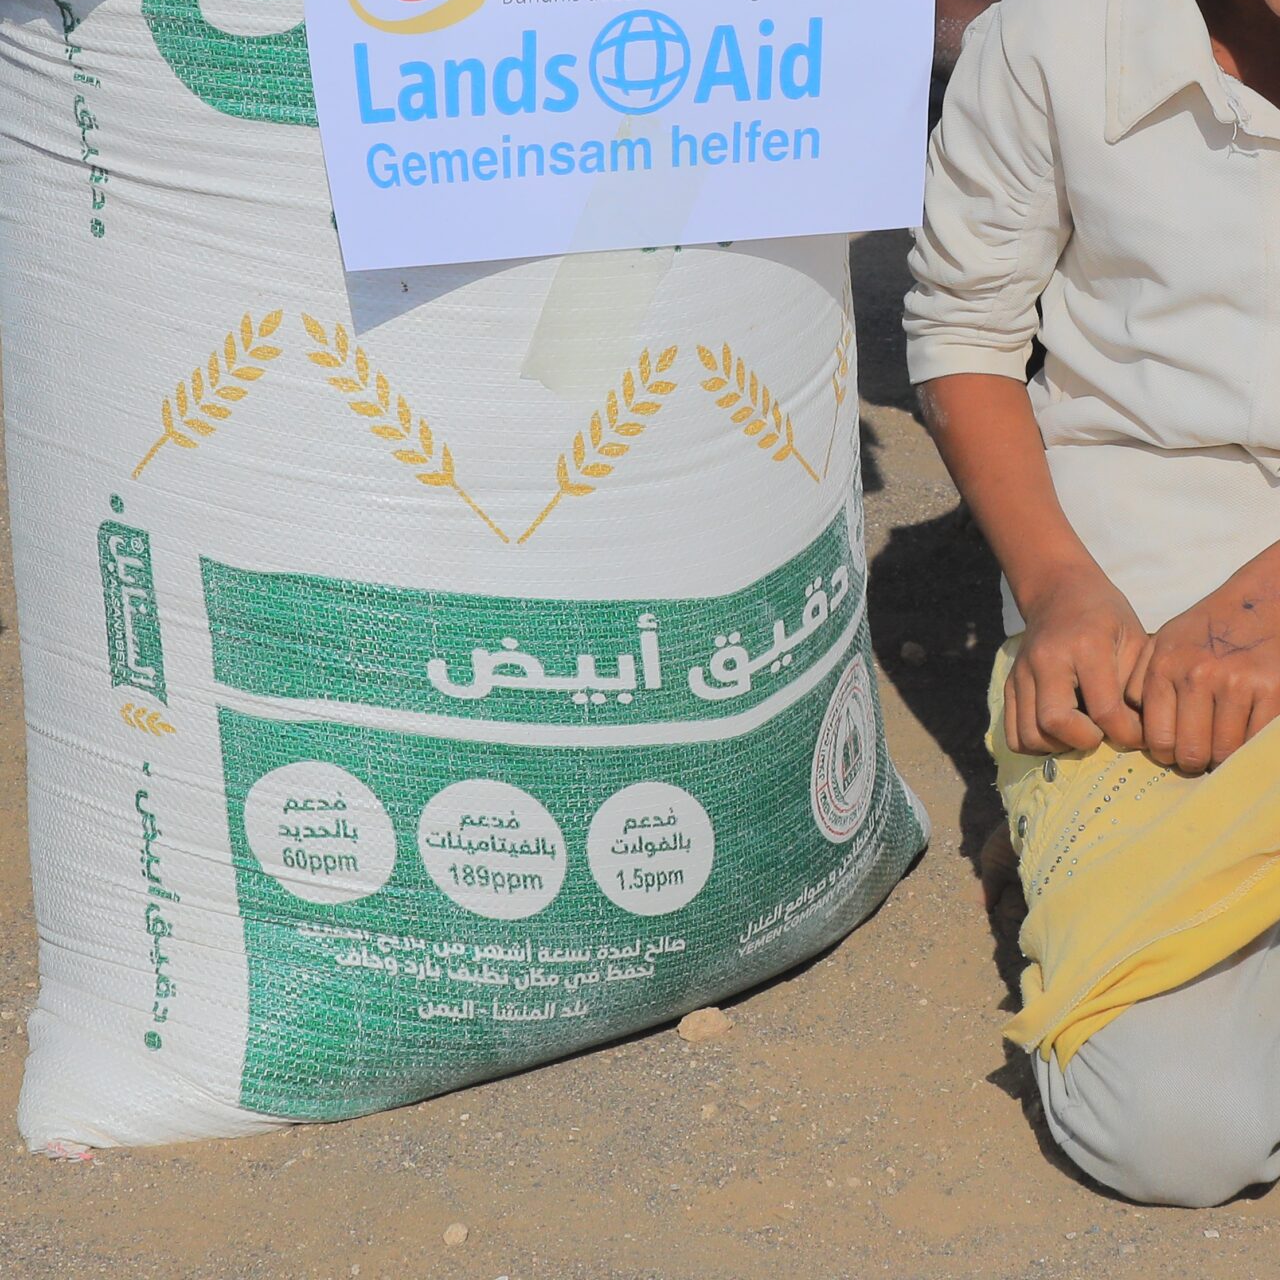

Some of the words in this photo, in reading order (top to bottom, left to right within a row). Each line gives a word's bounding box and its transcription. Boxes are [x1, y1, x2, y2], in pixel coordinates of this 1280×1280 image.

[353, 29, 580, 125] Lands
[693, 16, 823, 104] Aid
[366, 134, 652, 189] Gemeinsam
[671, 120, 821, 168] helfen
[688, 565, 849, 700] دقيق
[426, 613, 663, 705] أبيض
[277, 819, 359, 843] بالحديد
[425, 831, 557, 860] بالفيتامينات
[282, 849, 359, 876] 60ppm
[449, 863, 545, 892] 189ppm
[616, 869, 684, 893] 1.5ppm
[736, 926, 783, 957] YEMEN
[783, 890, 835, 932] COMPANY
[597, 938, 641, 960] لمدة
[645, 936, 686, 962] صالح
[514, 967, 561, 991] مكان
[418, 999, 475, 1022] اليمن
[492, 996, 556, 1021] المنشأ
